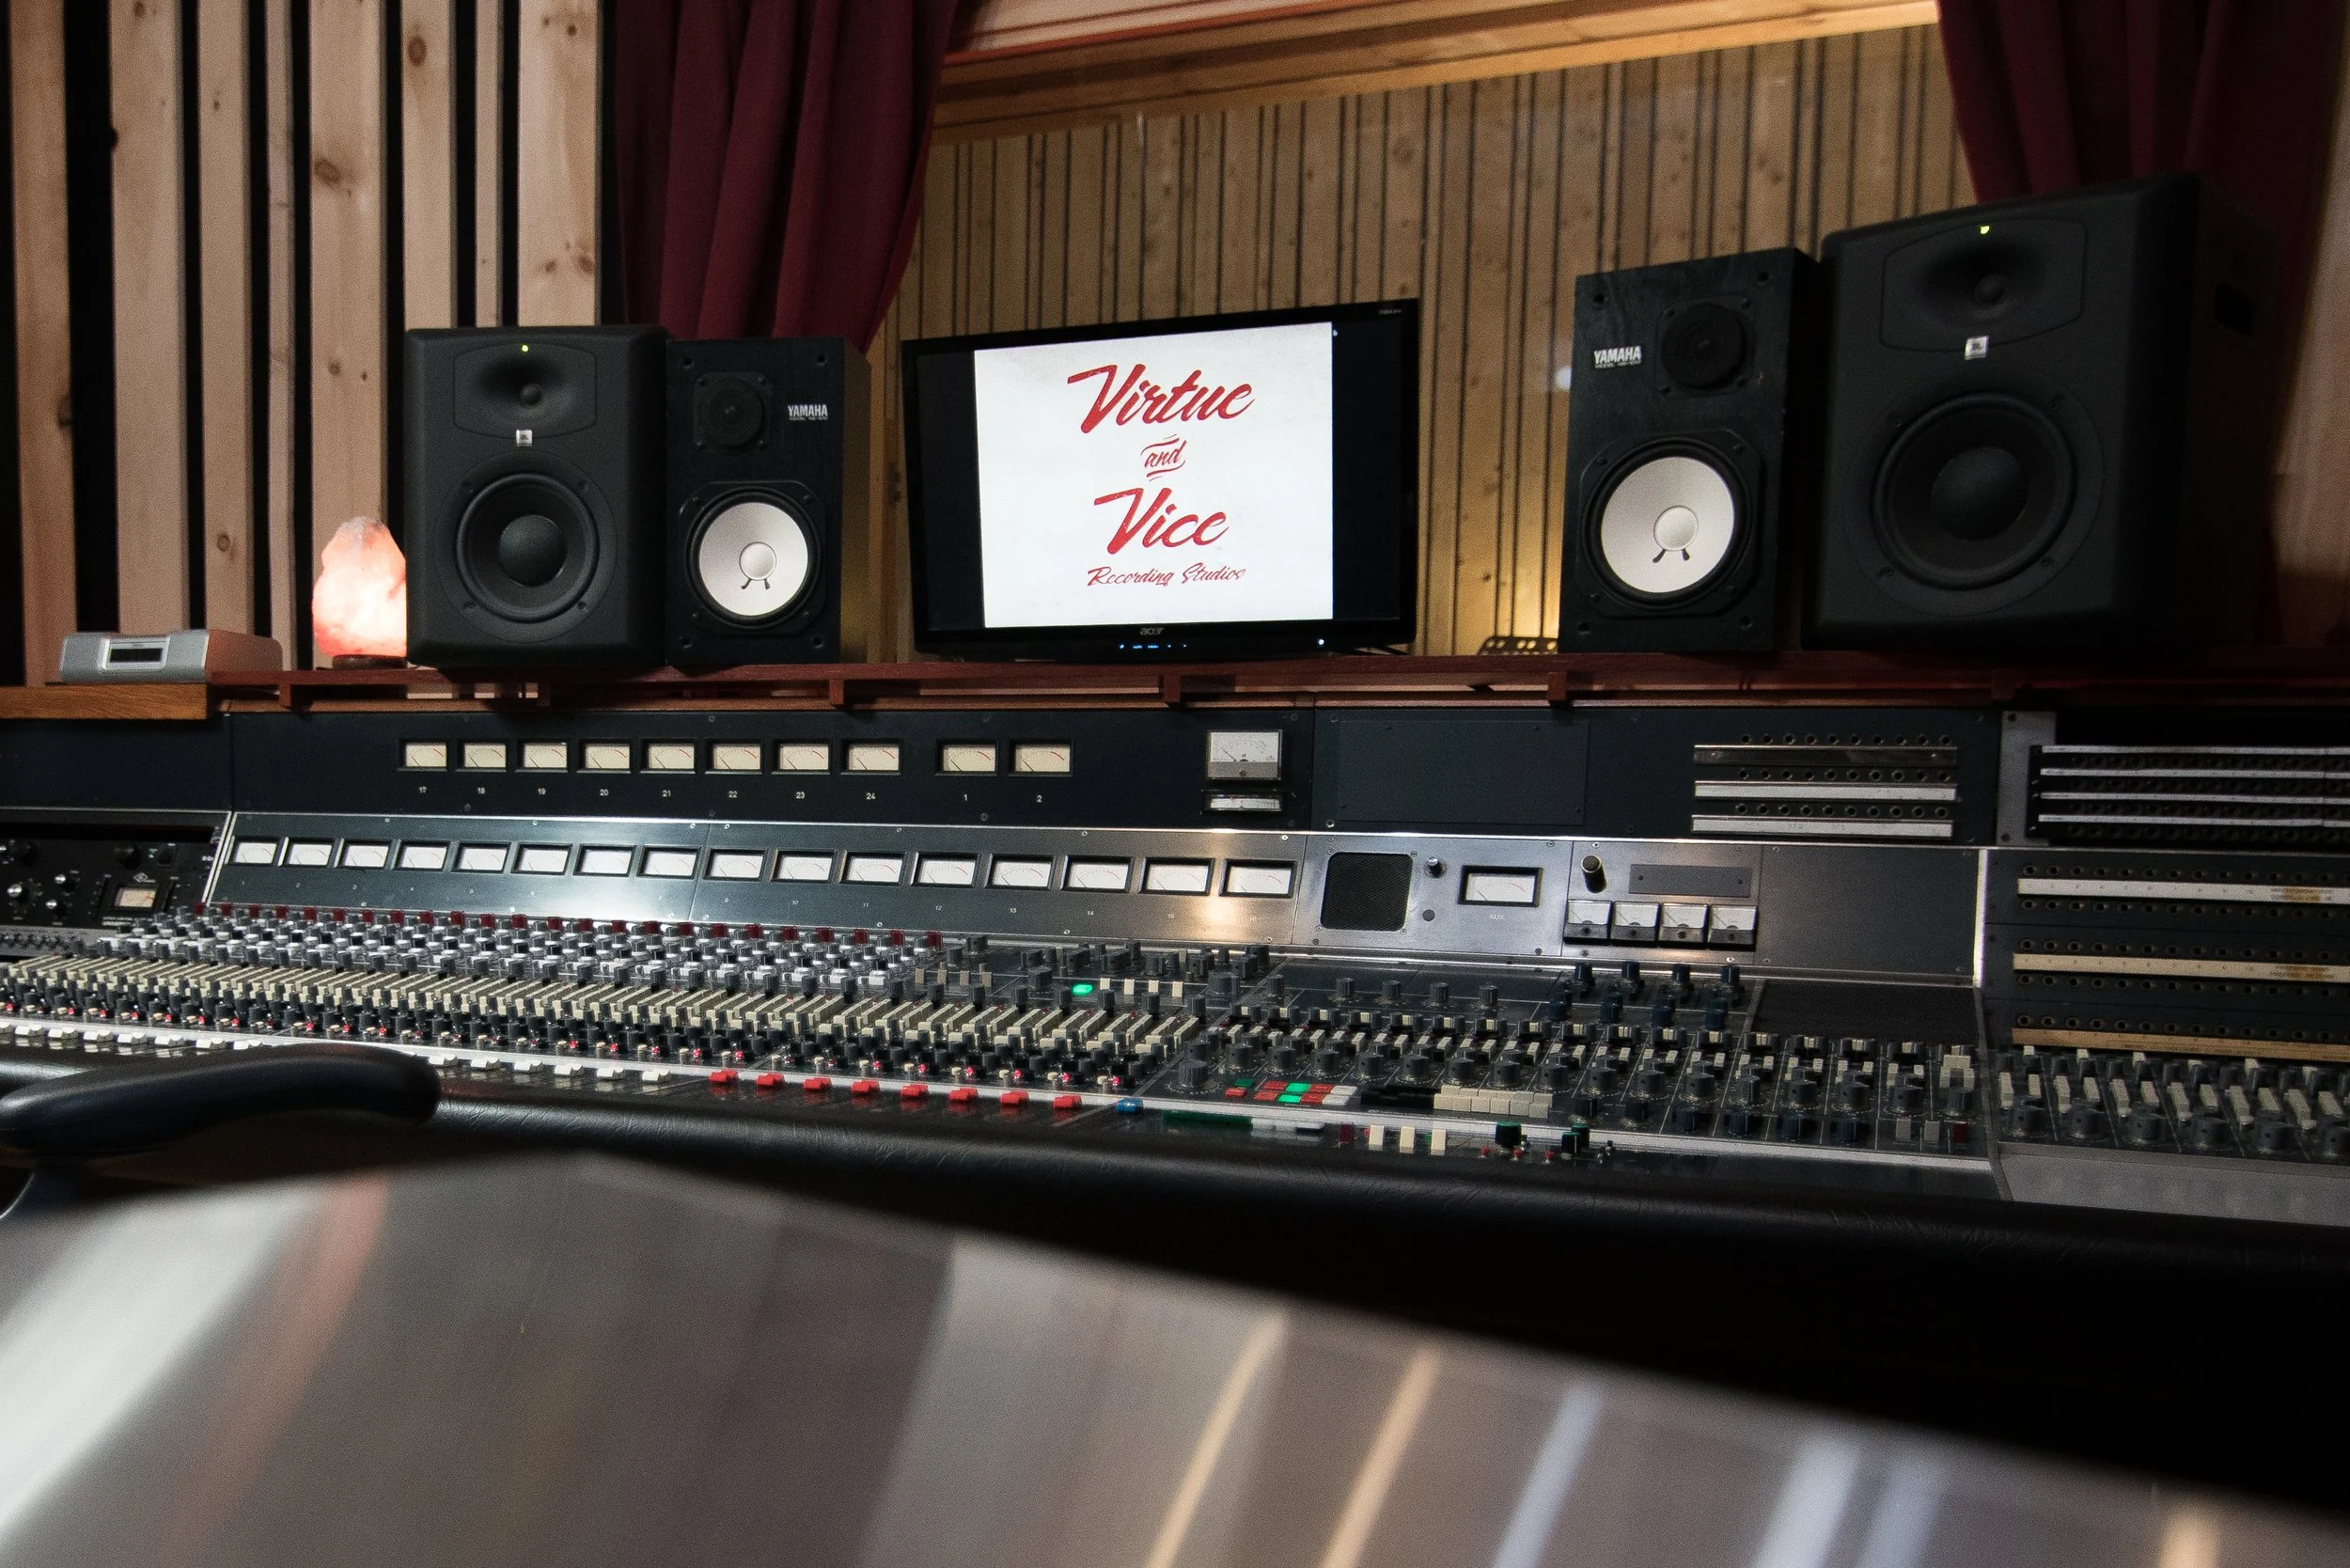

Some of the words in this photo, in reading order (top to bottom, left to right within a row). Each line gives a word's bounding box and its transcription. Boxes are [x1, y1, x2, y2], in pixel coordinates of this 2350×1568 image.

[1594, 346, 1642, 364] YAMAHA
[1067, 364, 1256, 434] Virtue
[788, 404, 828, 417] YAMAHA
[1144, 440, 1187, 468] and
[1094, 487, 1230, 555] Vice
[1088, 566, 1175, 587] Recording
[1182, 562, 1246, 585] Studios
[1139, 627, 1165, 635] acer
[796, 791, 806, 799] 23
[1037, 794, 1042, 803] 2
